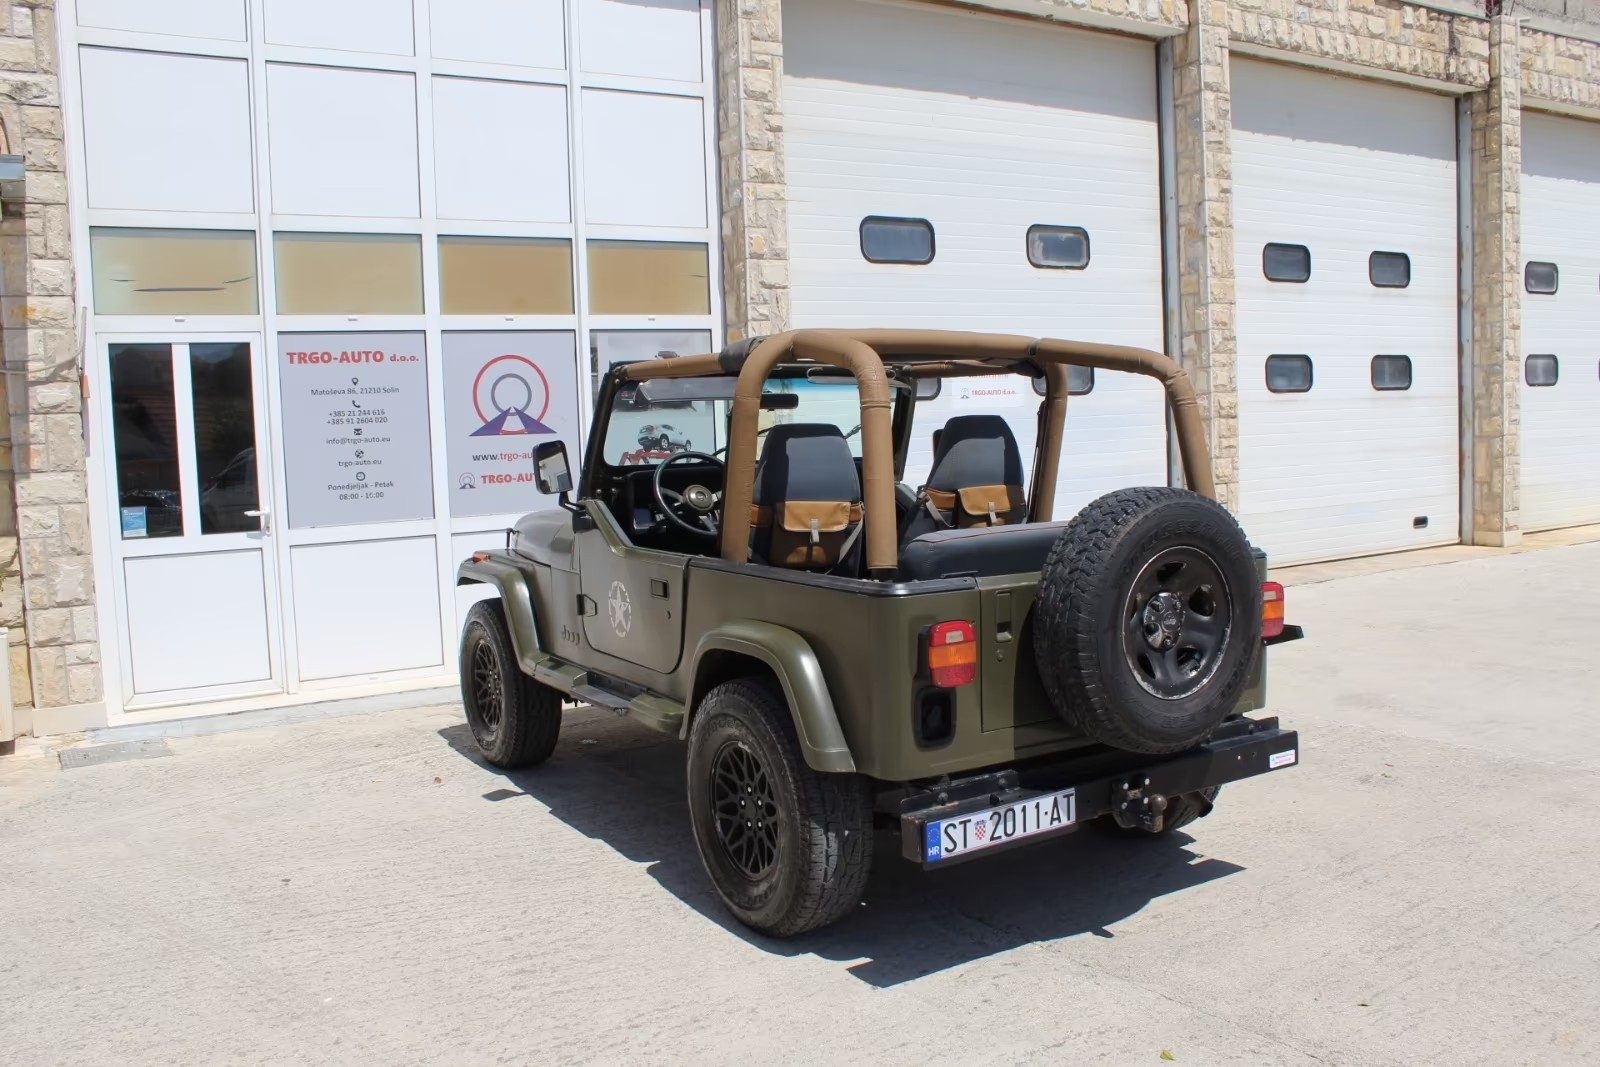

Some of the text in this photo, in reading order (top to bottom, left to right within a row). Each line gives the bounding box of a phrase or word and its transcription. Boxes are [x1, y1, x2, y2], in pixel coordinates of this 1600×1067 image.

[286, 351, 419, 364] TRGO-AUTO d.o.o.
[472, 452, 533, 461] www.trgo-au
[481, 473, 534, 484] TRGO-AU
[944, 818, 972, 853] ST
[928, 845, 940, 856] HR
